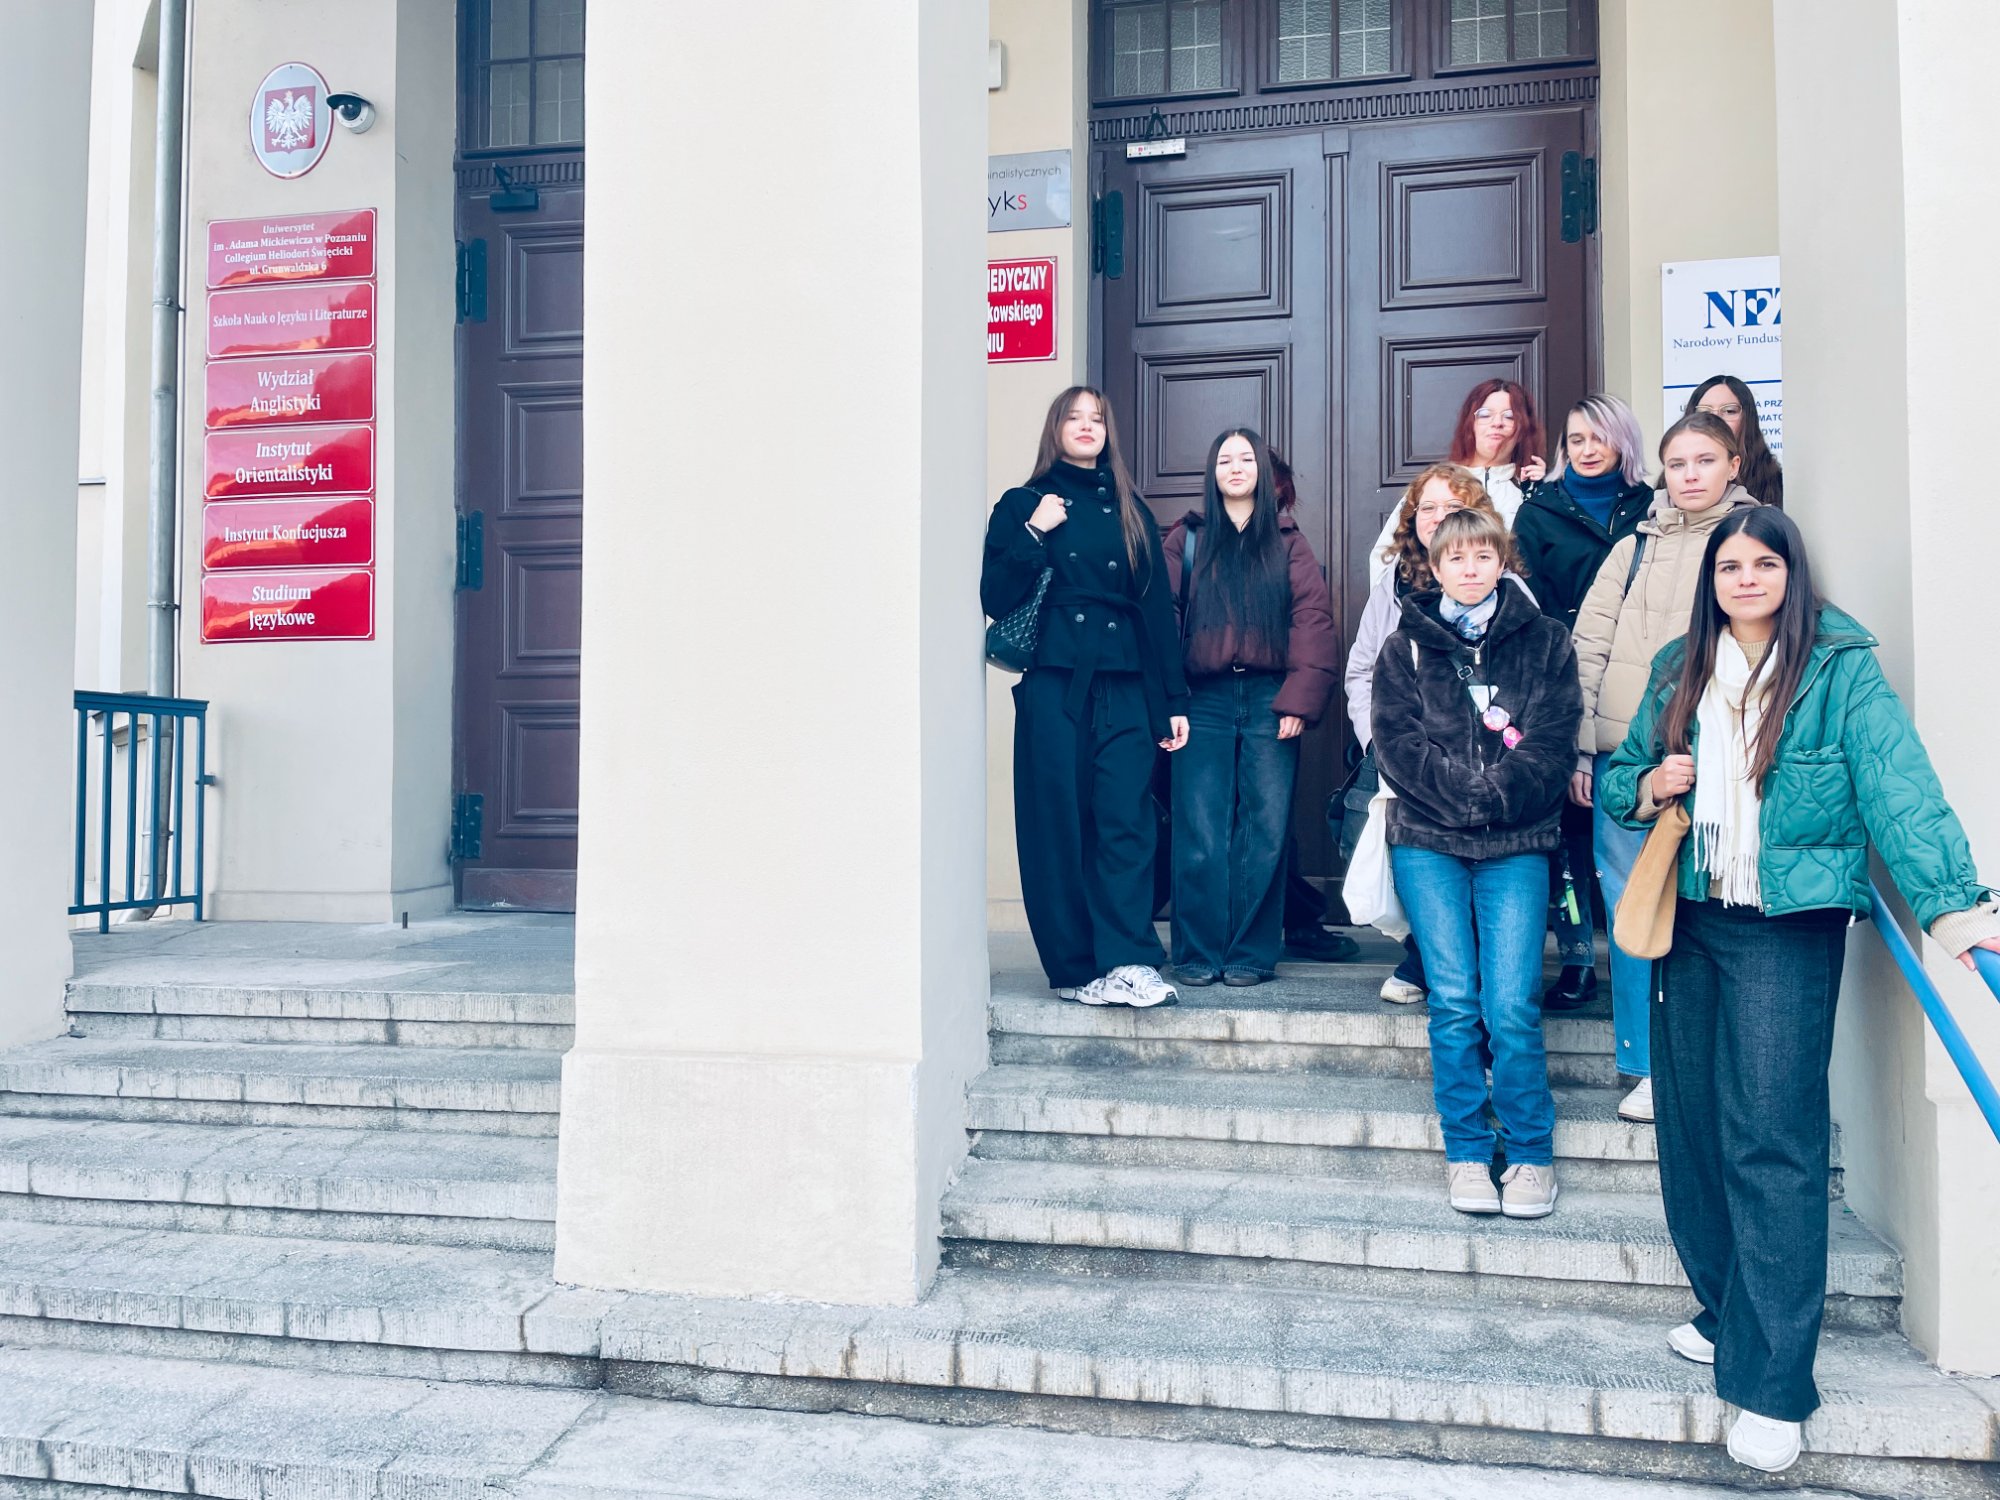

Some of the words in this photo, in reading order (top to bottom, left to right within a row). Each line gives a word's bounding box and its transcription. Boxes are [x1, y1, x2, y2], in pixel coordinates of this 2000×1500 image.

[988, 166, 1062, 180] inalistycznych
[263, 223, 315, 234] Uniwersytet
[229, 239, 259, 250] Adama
[260, 236, 313, 247] Mickiewicza
[324, 232, 367, 243] Poznaniu
[225, 252, 267, 265] Collegium
[268, 248, 310, 260] Heliodori
[311, 245, 353, 258] Święcicki
[249, 264, 261, 275] ul.
[261, 262, 319, 274] Grunwaldzka
[320, 260, 327, 271] 6
[213, 313, 242, 327] Szkoła
[243, 312, 268, 325] Nauk
[269, 315, 275, 323] o
[277, 309, 308, 326] Języku
[315, 308, 368, 321] Literaturze
[1673, 336, 1733, 349] Narodowy
[1736, 332, 1782, 346] Fundus
[257, 369, 315, 391] Wydział
[250, 394, 321, 416] Anglistyki
[256, 441, 312, 461] Instytut
[235, 464, 334, 485] Orientalistyki
[224, 527, 269, 545] Instytut
[272, 523, 347, 544] Konfucjusza
[251, 584, 311, 601] Studium
[249, 609, 315, 631] Językowe
